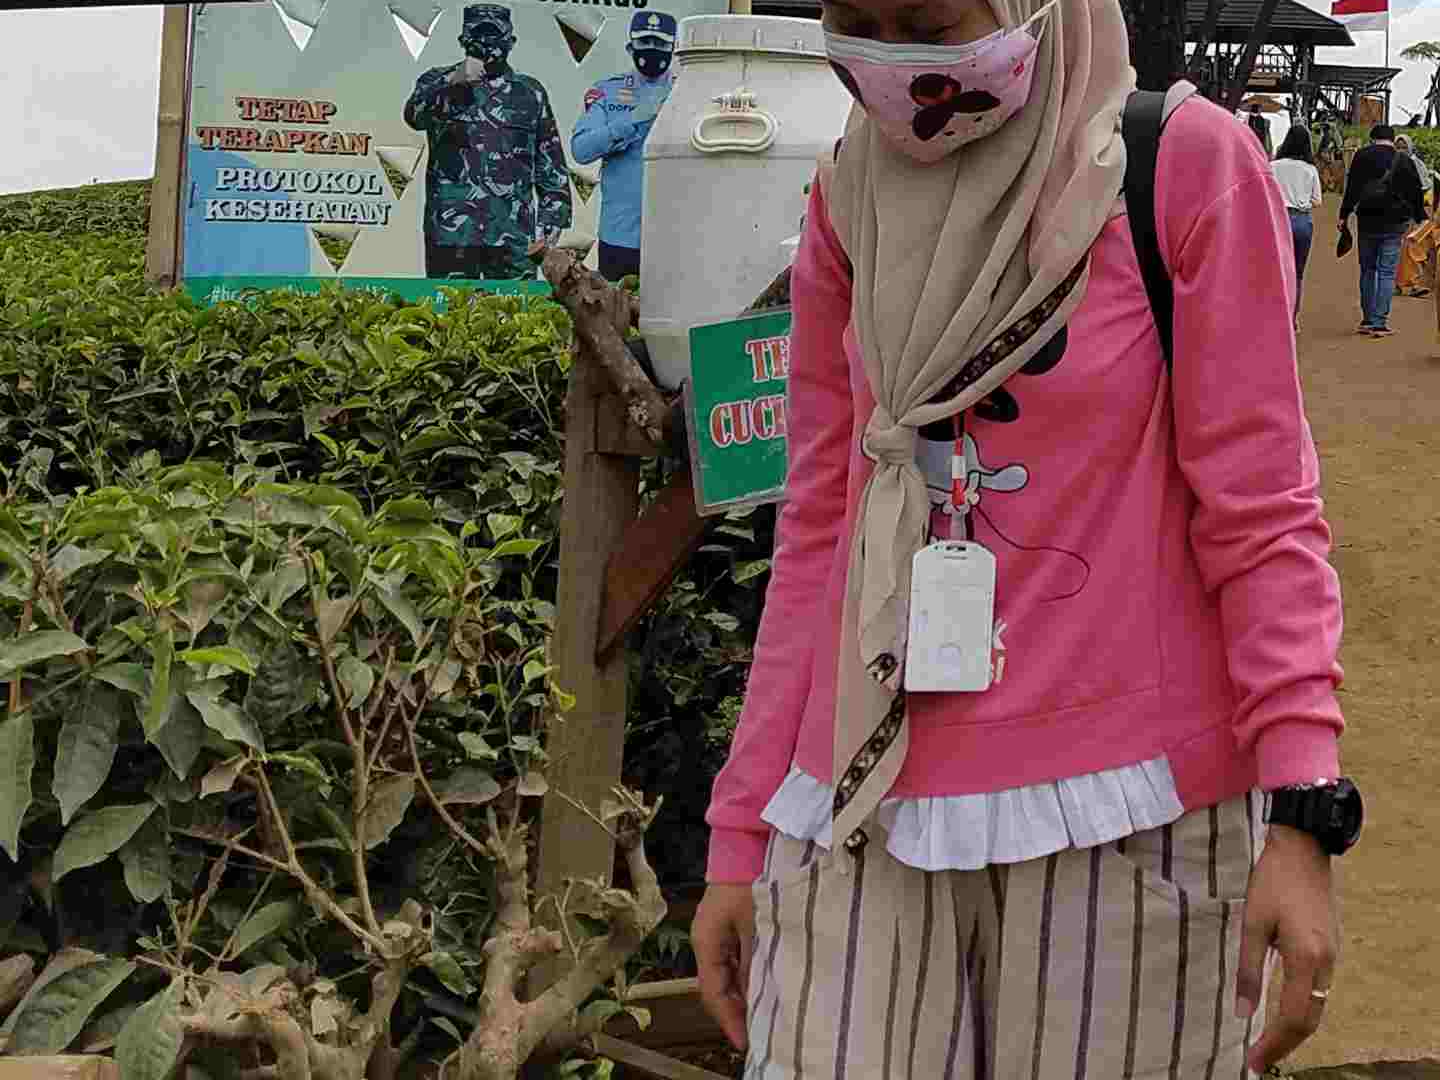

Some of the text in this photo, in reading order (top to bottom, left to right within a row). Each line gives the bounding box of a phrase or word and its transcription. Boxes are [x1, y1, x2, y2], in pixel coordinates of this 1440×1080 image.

[235, 96, 337, 123] TETAP
[196, 125, 372, 157] TERAPKAN
[215, 167, 384, 195] PROTOKOL
[203, 198, 391, 226] KESEHATAN
[745, 333, 791, 383] TE
